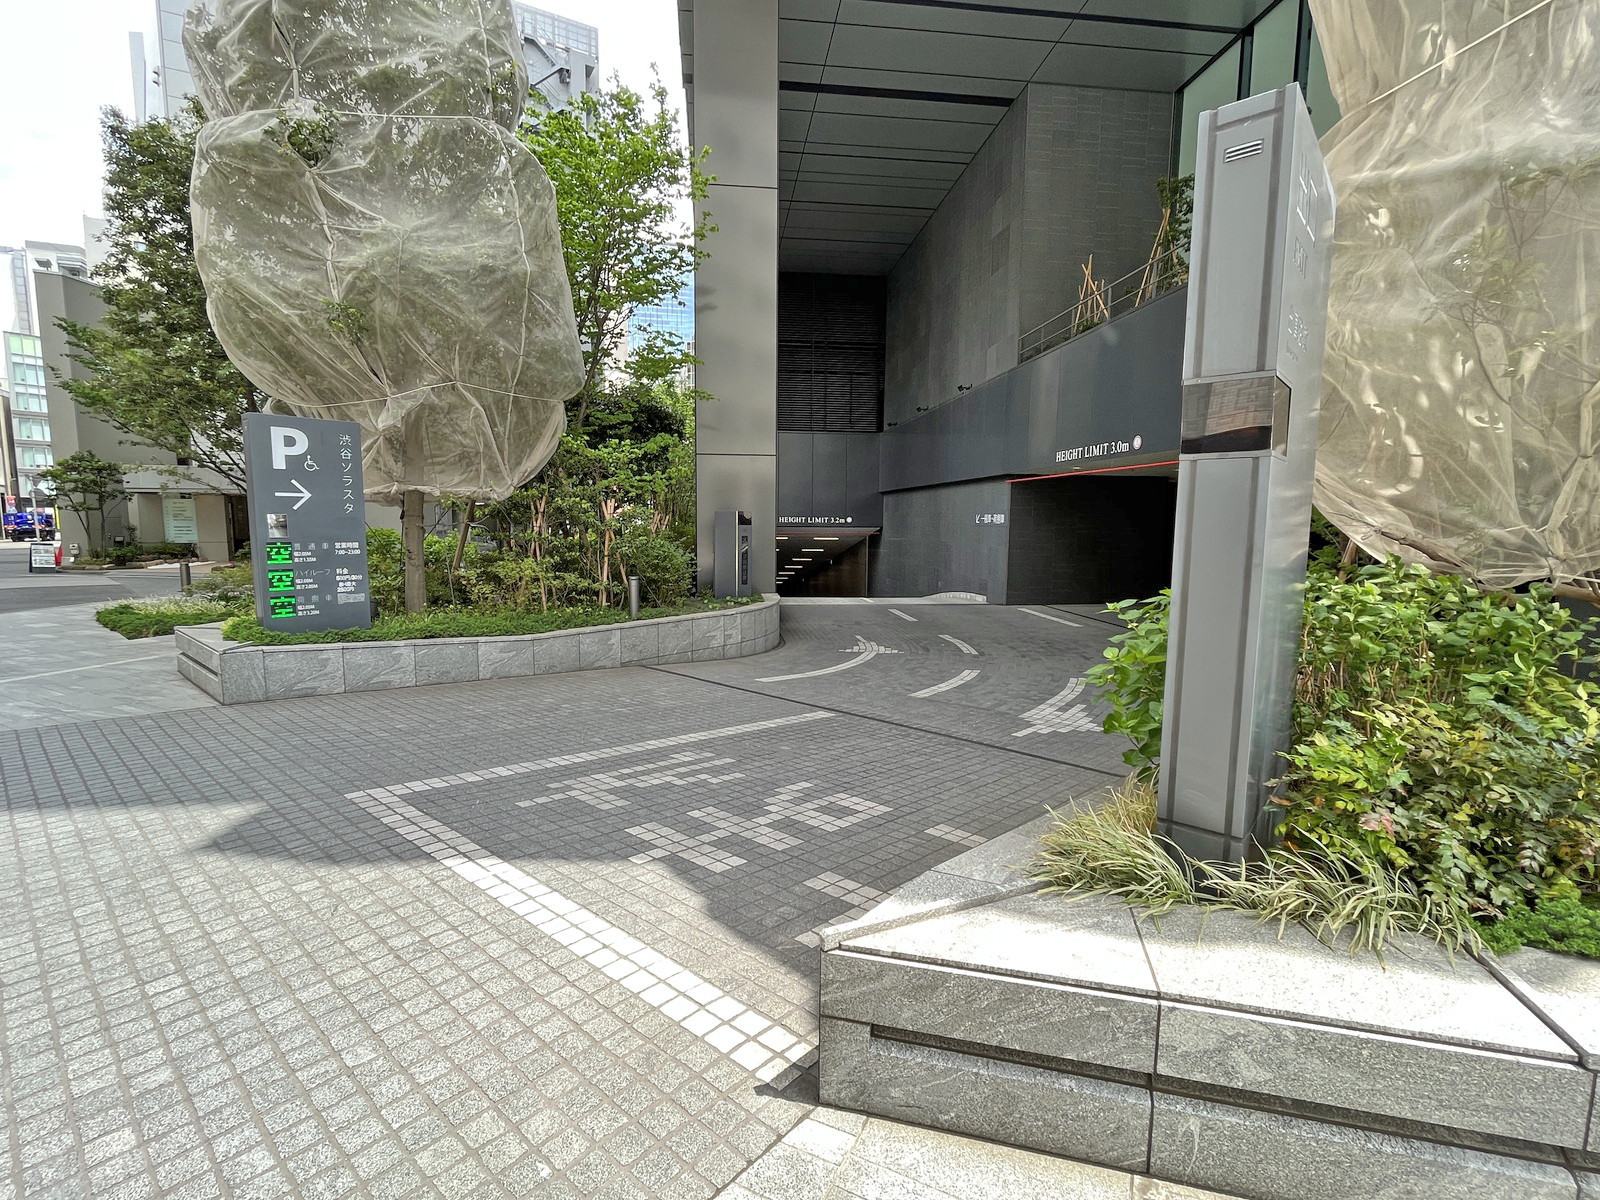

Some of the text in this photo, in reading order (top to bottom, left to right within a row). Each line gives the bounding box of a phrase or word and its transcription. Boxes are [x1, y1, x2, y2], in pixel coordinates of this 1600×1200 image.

[270, 426, 309, 470] P
[1055, 440, 1129, 462] HEIGHT LIMIT 3.0m
[339, 433, 355, 515] 渋谷ソラスタ
[807, 516, 829, 524] LIMIT
[830, 516, 846, 524] 3.2m
